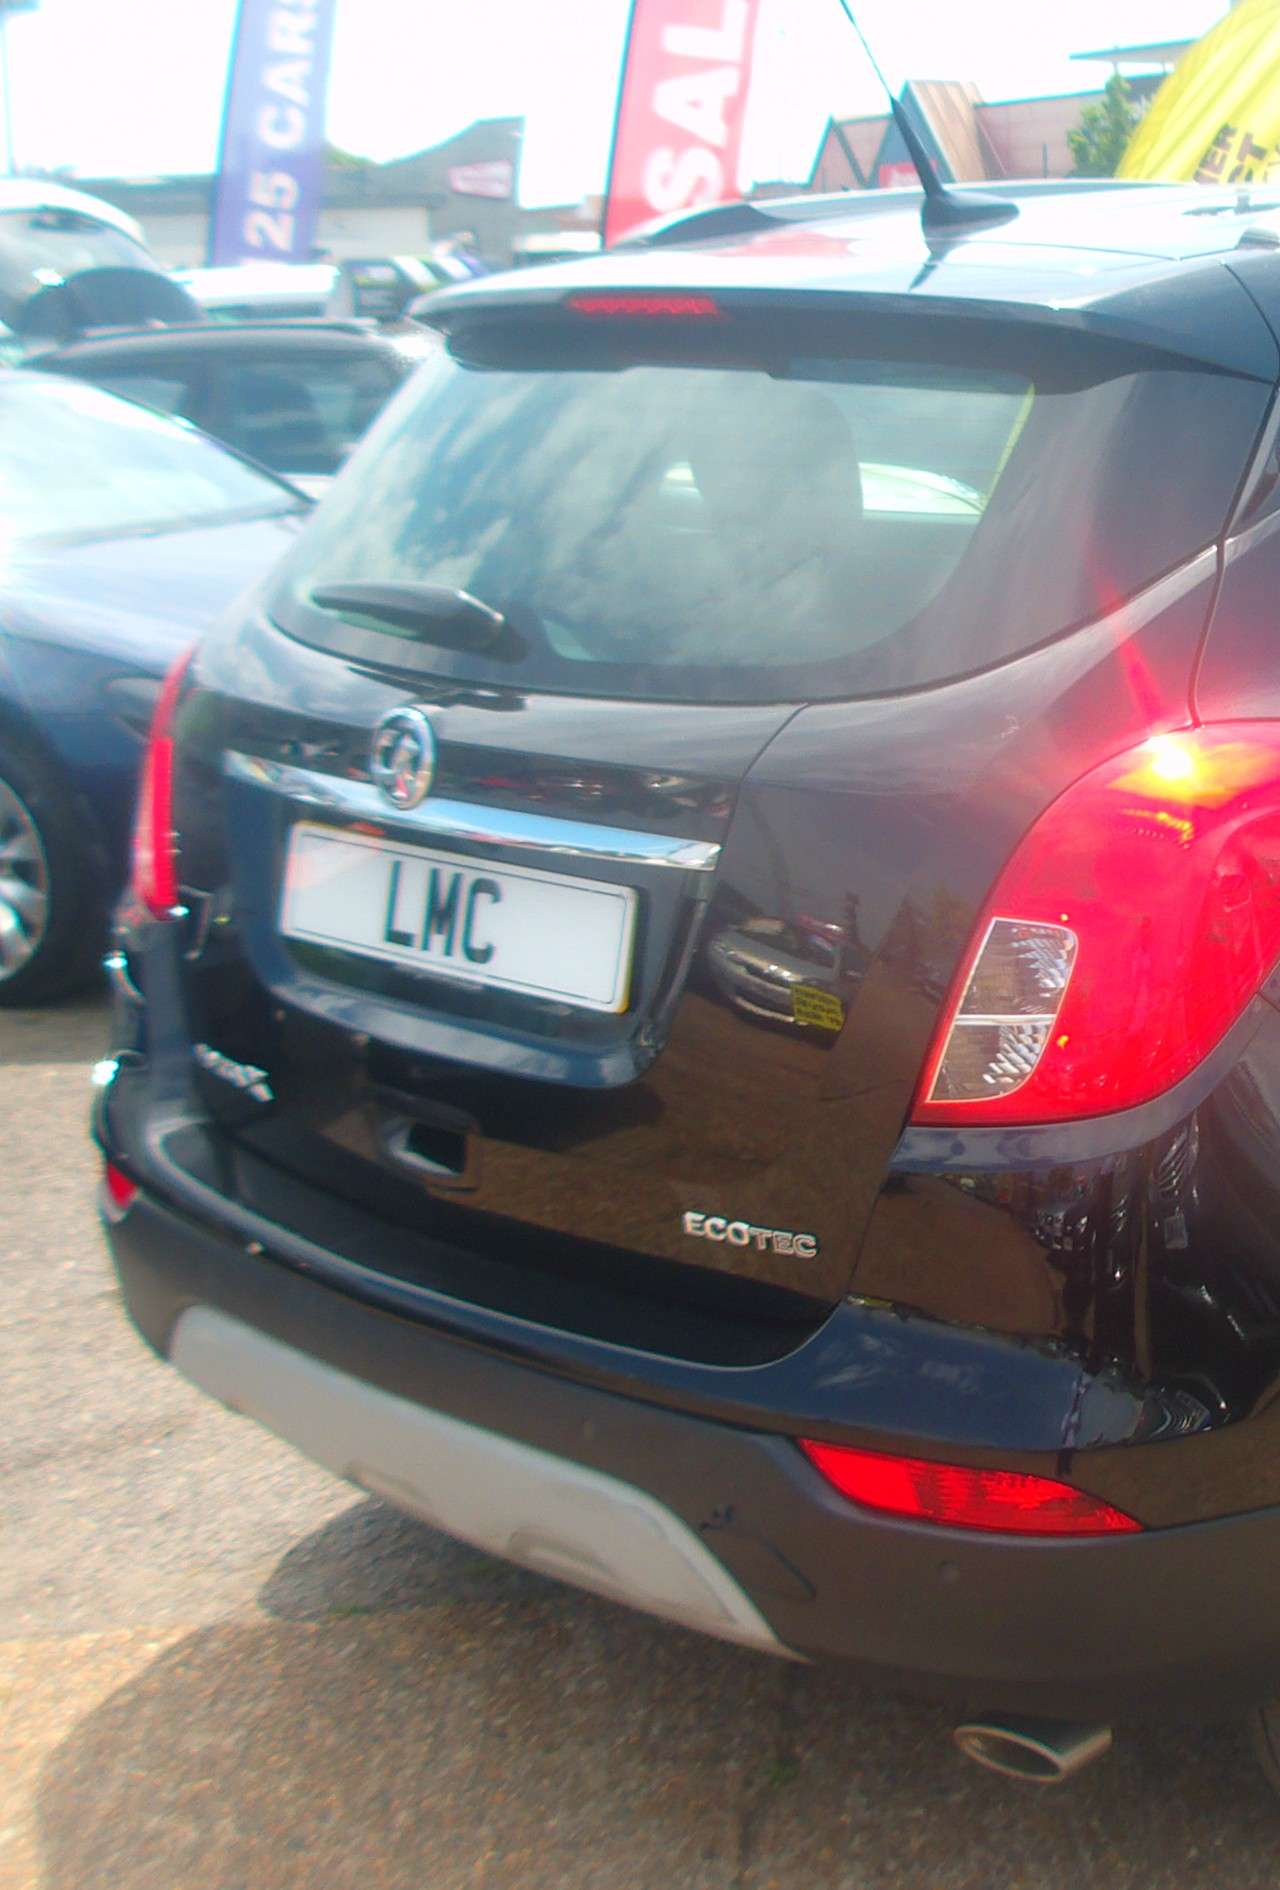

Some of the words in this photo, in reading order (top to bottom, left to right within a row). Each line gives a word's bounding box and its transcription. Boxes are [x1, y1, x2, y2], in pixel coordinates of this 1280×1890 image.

[241, 169, 300, 262] 25
[384, 860, 503, 965] LMC
[682, 1211, 818, 1258] ECOTEC
